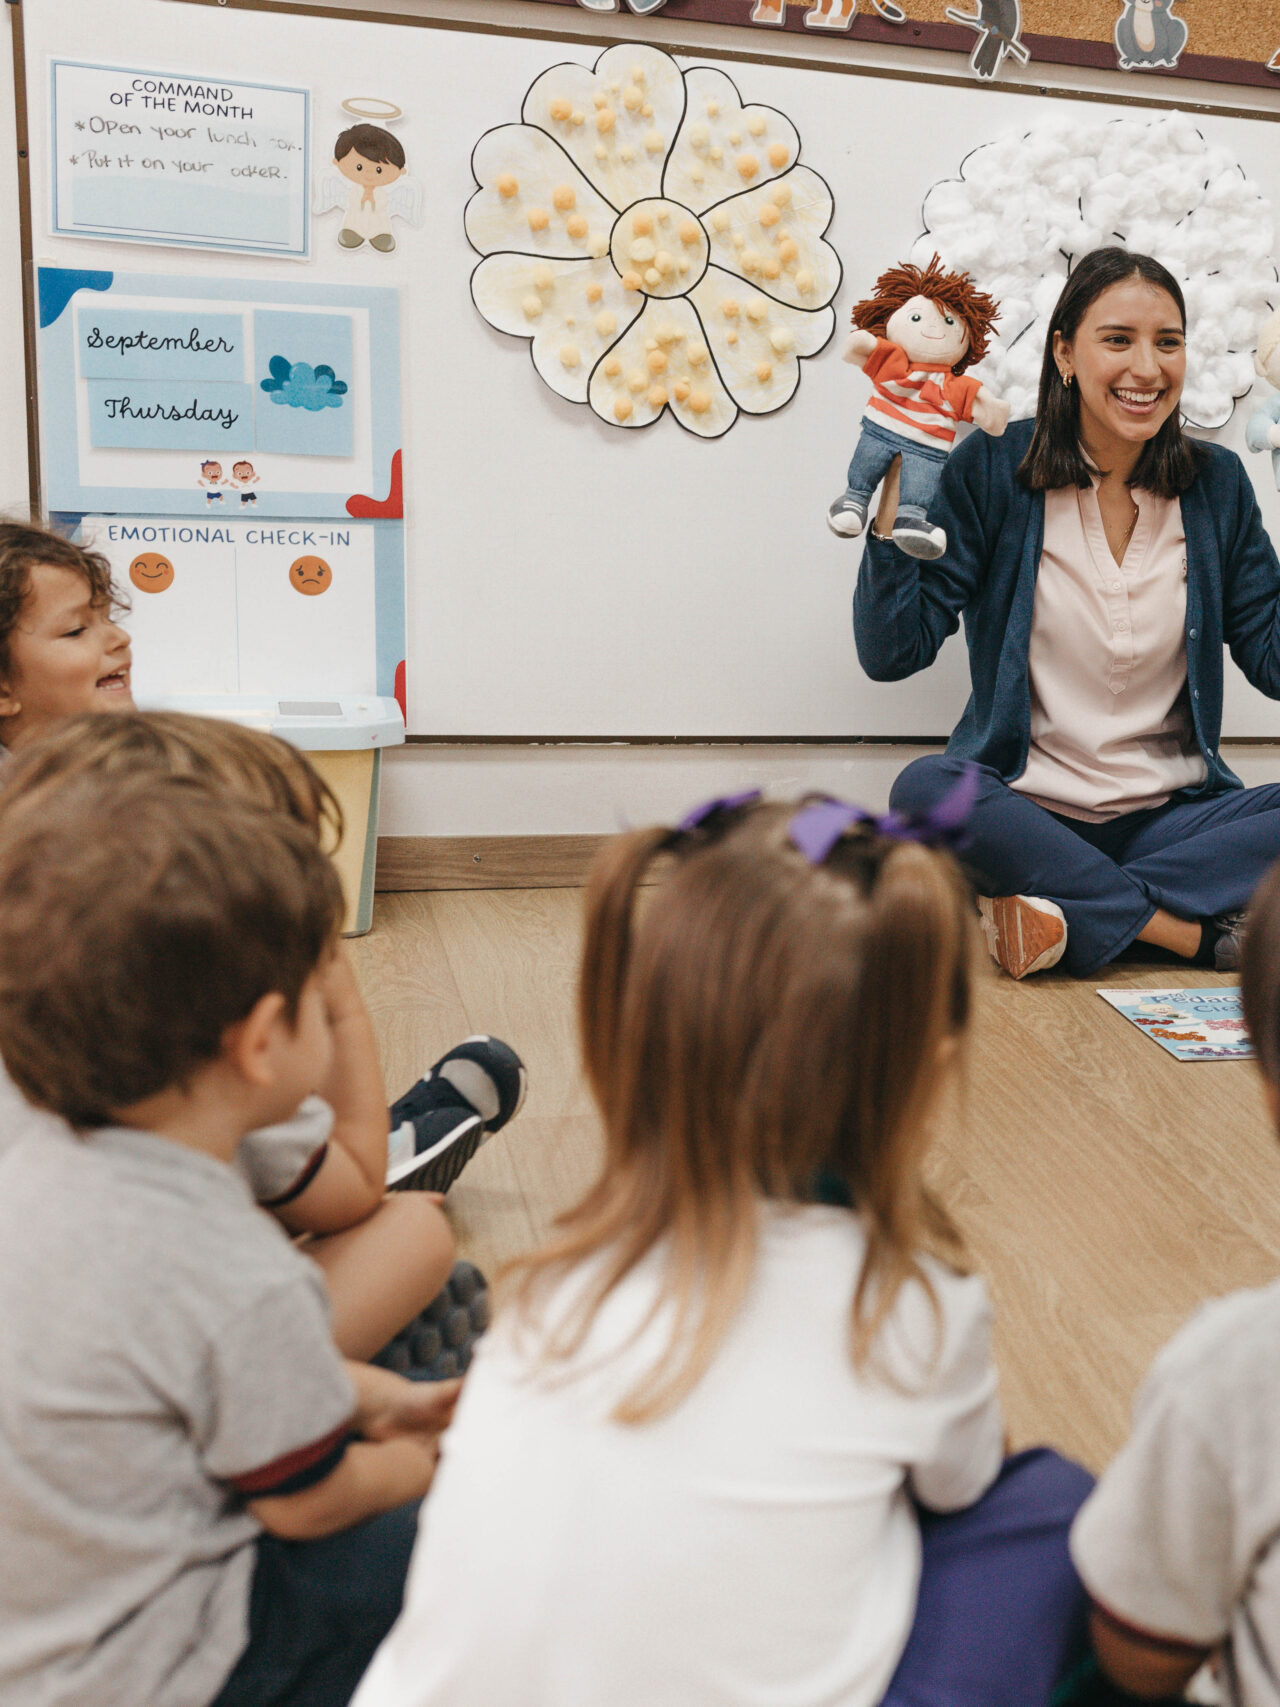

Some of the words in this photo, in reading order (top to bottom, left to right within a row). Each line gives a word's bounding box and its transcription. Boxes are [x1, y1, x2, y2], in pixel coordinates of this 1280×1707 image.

[132, 79, 233, 102] COMMAND
[110, 93, 134, 107] OF
[141, 95, 176, 112] THE
[184, 100, 253, 119] MONTH
[89, 116, 142, 135] Open
[150, 126, 197, 141] your
[207, 127, 257, 148] lunch
[82, 149, 112, 168] Put
[142, 158, 165, 170] on
[171, 160, 214, 173] your
[87, 327, 234, 356] September
[104, 396, 239, 430] Thursday
[108, 525, 236, 544] EMOTIONAL
[246, 529, 351, 547] CHECK-IN
[1193, 1004, 1242, 1012] Ciel
